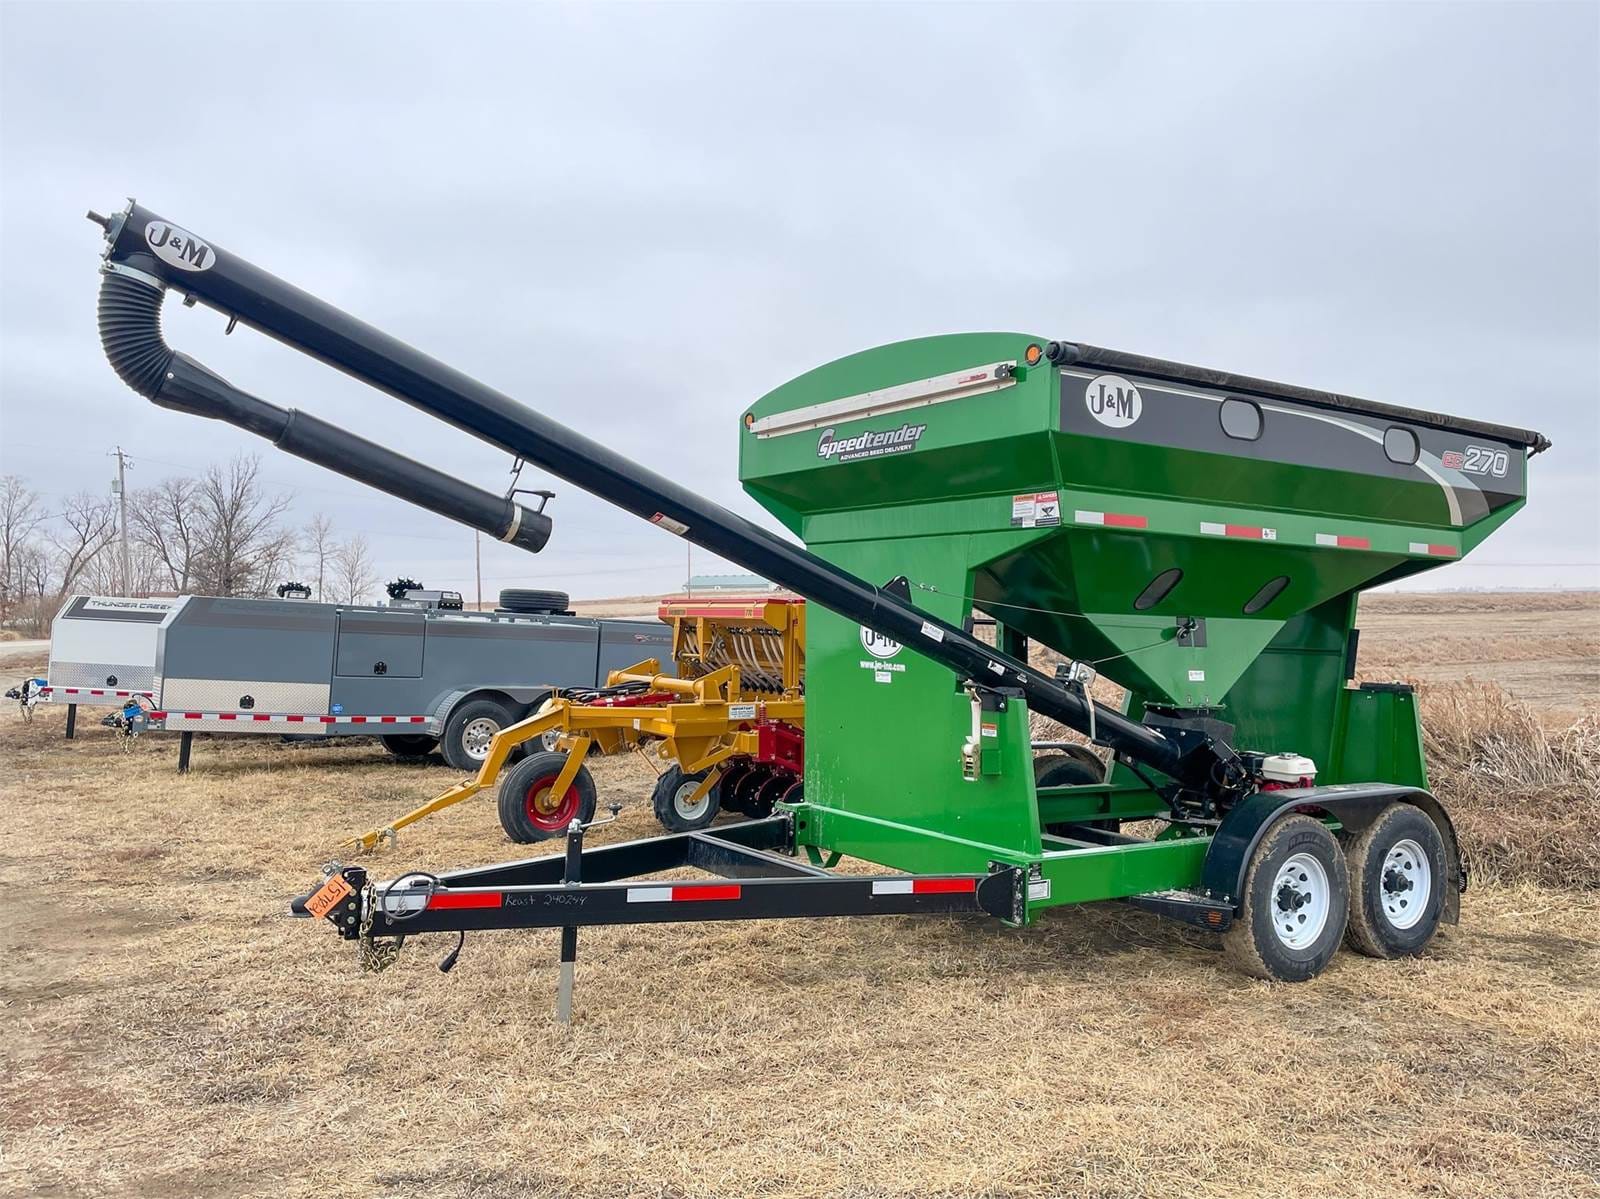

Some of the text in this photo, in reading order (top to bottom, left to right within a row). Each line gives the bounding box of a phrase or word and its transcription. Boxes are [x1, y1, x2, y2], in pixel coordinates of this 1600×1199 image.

[148, 225, 209, 268] J&M
[1089, 384, 1134, 419] J&M
[818, 424, 926, 458] Speedtender
[840, 451, 869, 461] ADVANCED
[884, 444, 912, 454] DELIVERY
[92, 600, 137, 609] THUNDER
